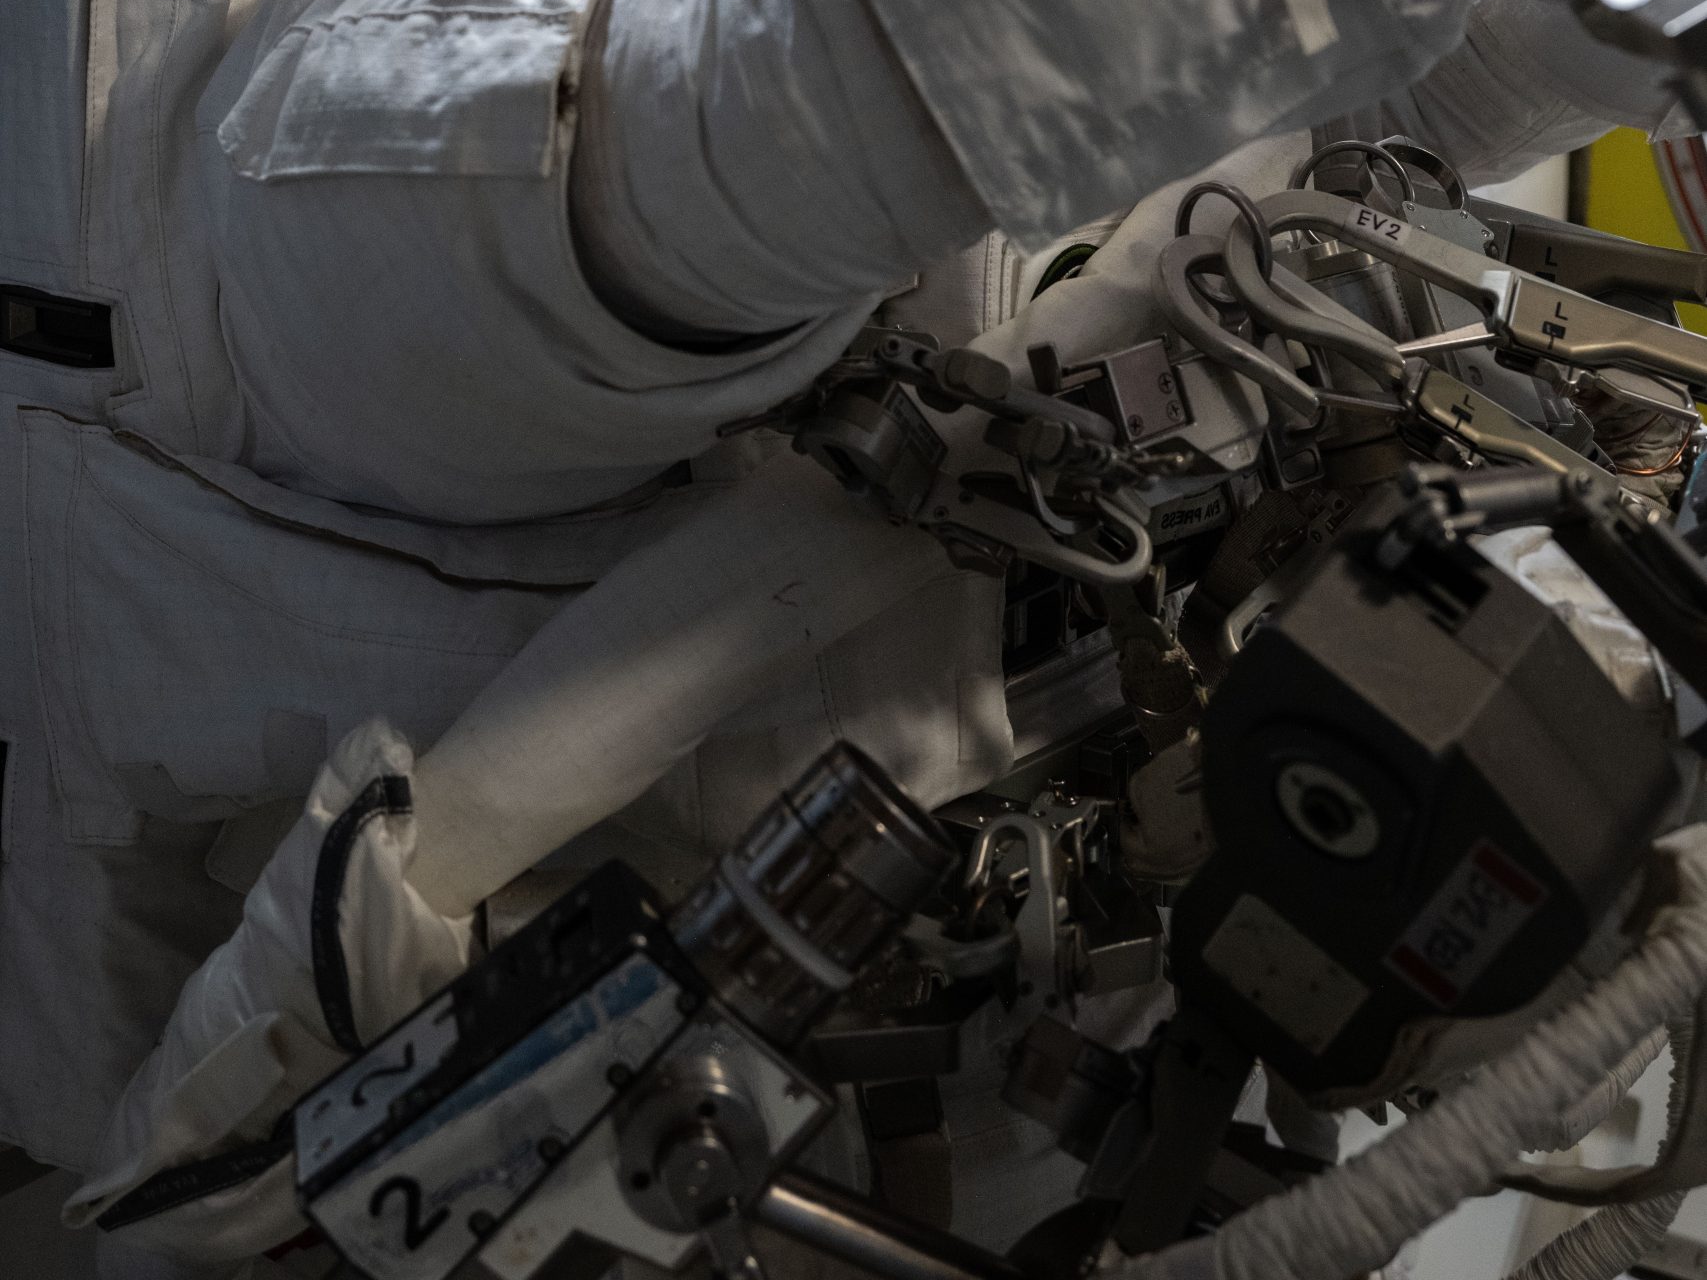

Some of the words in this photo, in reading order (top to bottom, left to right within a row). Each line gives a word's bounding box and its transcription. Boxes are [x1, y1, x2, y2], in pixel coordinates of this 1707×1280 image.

[1546, 246, 1558, 266] L
[1555, 301, 1569, 321] L
[1463, 394, 1476, 411] L
[369, 1174, 451, 1251] 2
